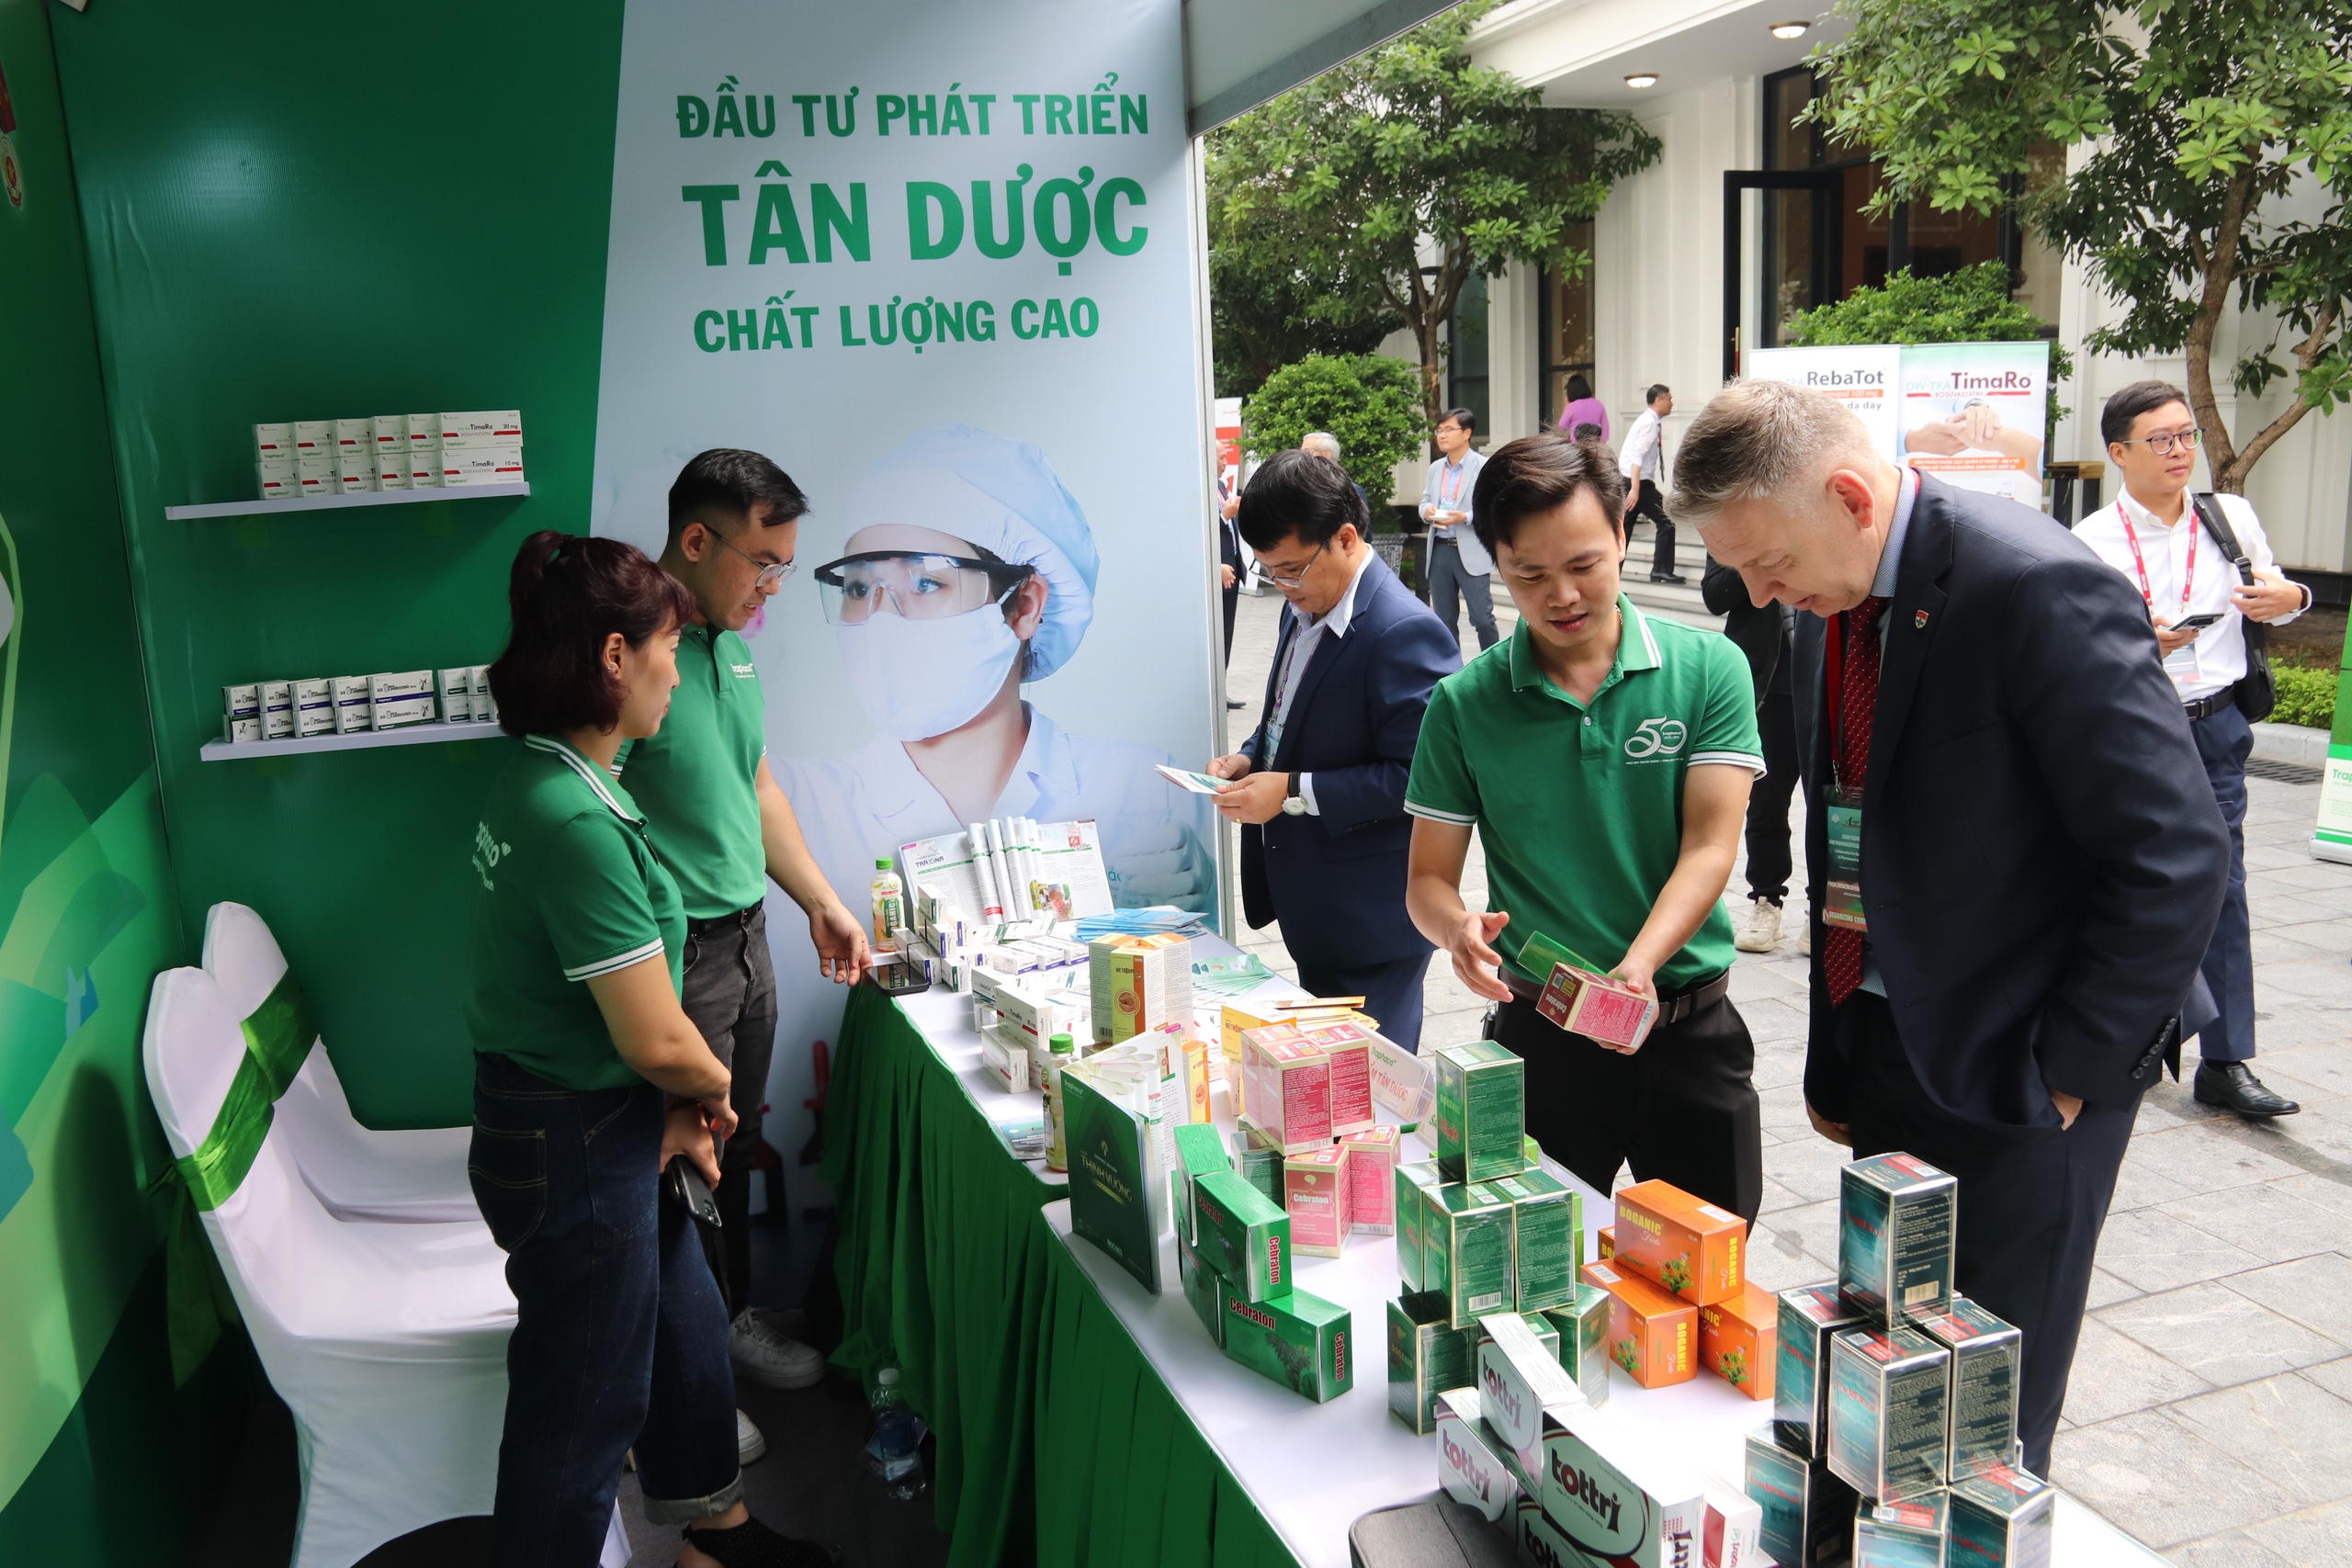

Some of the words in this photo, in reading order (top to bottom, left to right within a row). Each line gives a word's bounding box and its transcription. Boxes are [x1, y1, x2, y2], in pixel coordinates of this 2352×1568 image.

[676, 74, 776, 138] ĐẦU
[792, 85, 860, 138] TƯ
[876, 82, 997, 136] PHÁT
[1013, 72, 1148, 135] TRIỂN
[682, 160, 871, 266] TÂN
[906, 163, 1148, 276] DƯỢC
[694, 289, 820, 353] CHẤT
[840, 295, 996, 354] LƯỢNG
[1011, 297, 1100, 340] CAO
[1807, 370, 1883, 386] RebaTot
[1906, 381, 1951, 391] DW-TRA
[1951, 371, 2031, 390] TimaRo
[1862, 400, 1883, 412] dày
[1624, 715, 1688, 758] 50
[915, 856, 944, 868] TRAXINA
[1371, 1046, 1394, 1066] Traphaco
[1377, 1071, 1391, 1089] TÂN
[1390, 1080, 1409, 1101] DƯỢC
[1197, 1192, 1224, 1228] Cebraton
[1293, 1193, 1329, 1204] Cebraton
[1619, 1205, 1661, 1236] BOGANIC
[1268, 1235, 1281, 1285] Cebraton
[1728, 1236, 1738, 1288] BOGANIC
[1229, 1296, 1275, 1330] Cebraton
[1334, 1332, 1345, 1382] Cebraton
[1677, 1322, 1687, 1372] BOGANIC
[1482, 1353, 1522, 1430] tottri
[1442, 1427, 1491, 1505] tottri
[1551, 1447, 1623, 1535] tottri
